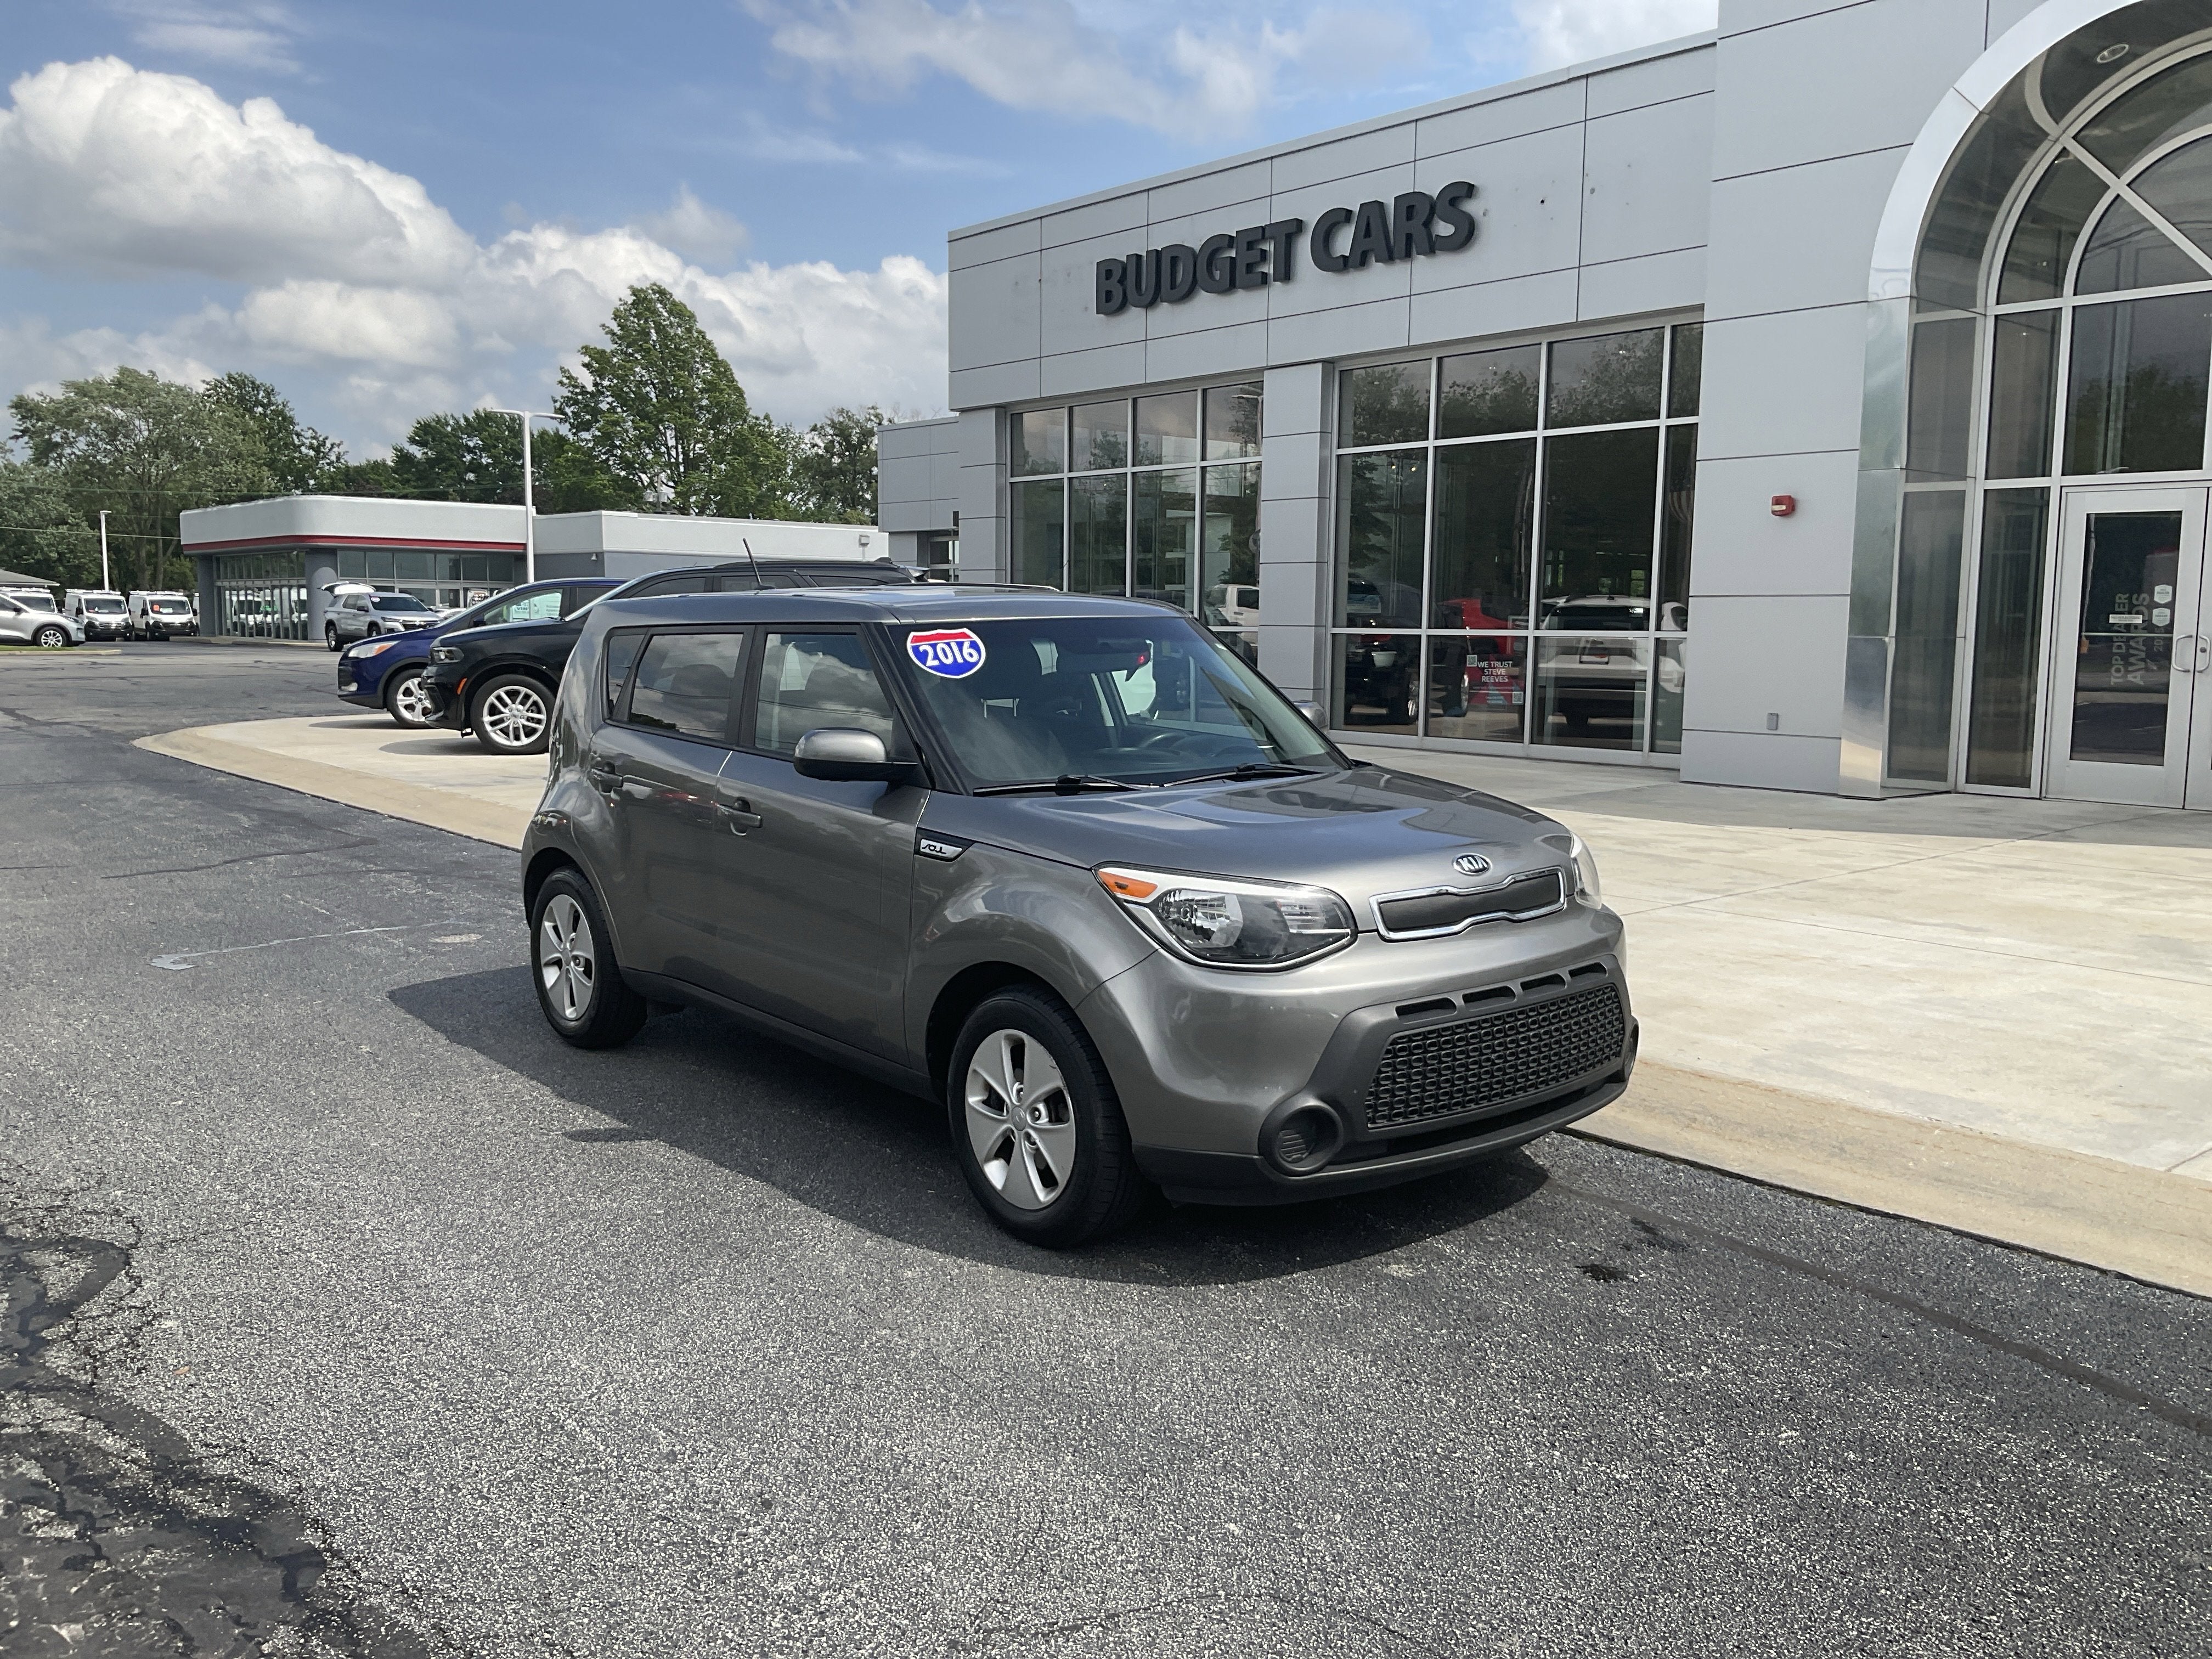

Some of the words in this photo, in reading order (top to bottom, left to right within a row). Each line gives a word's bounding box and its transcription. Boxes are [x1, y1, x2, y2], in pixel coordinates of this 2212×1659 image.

[1096, 218, 1303, 315] BUDGET
[1310, 181, 1475, 273] CARS
[2112, 593, 2129, 653] DEAER
[2127, 593, 2150, 685] AWARDS
[919, 641, 979, 667] 2016
[2111, 656, 2125, 685] TOP
[1457, 856, 1488, 871] KIA
